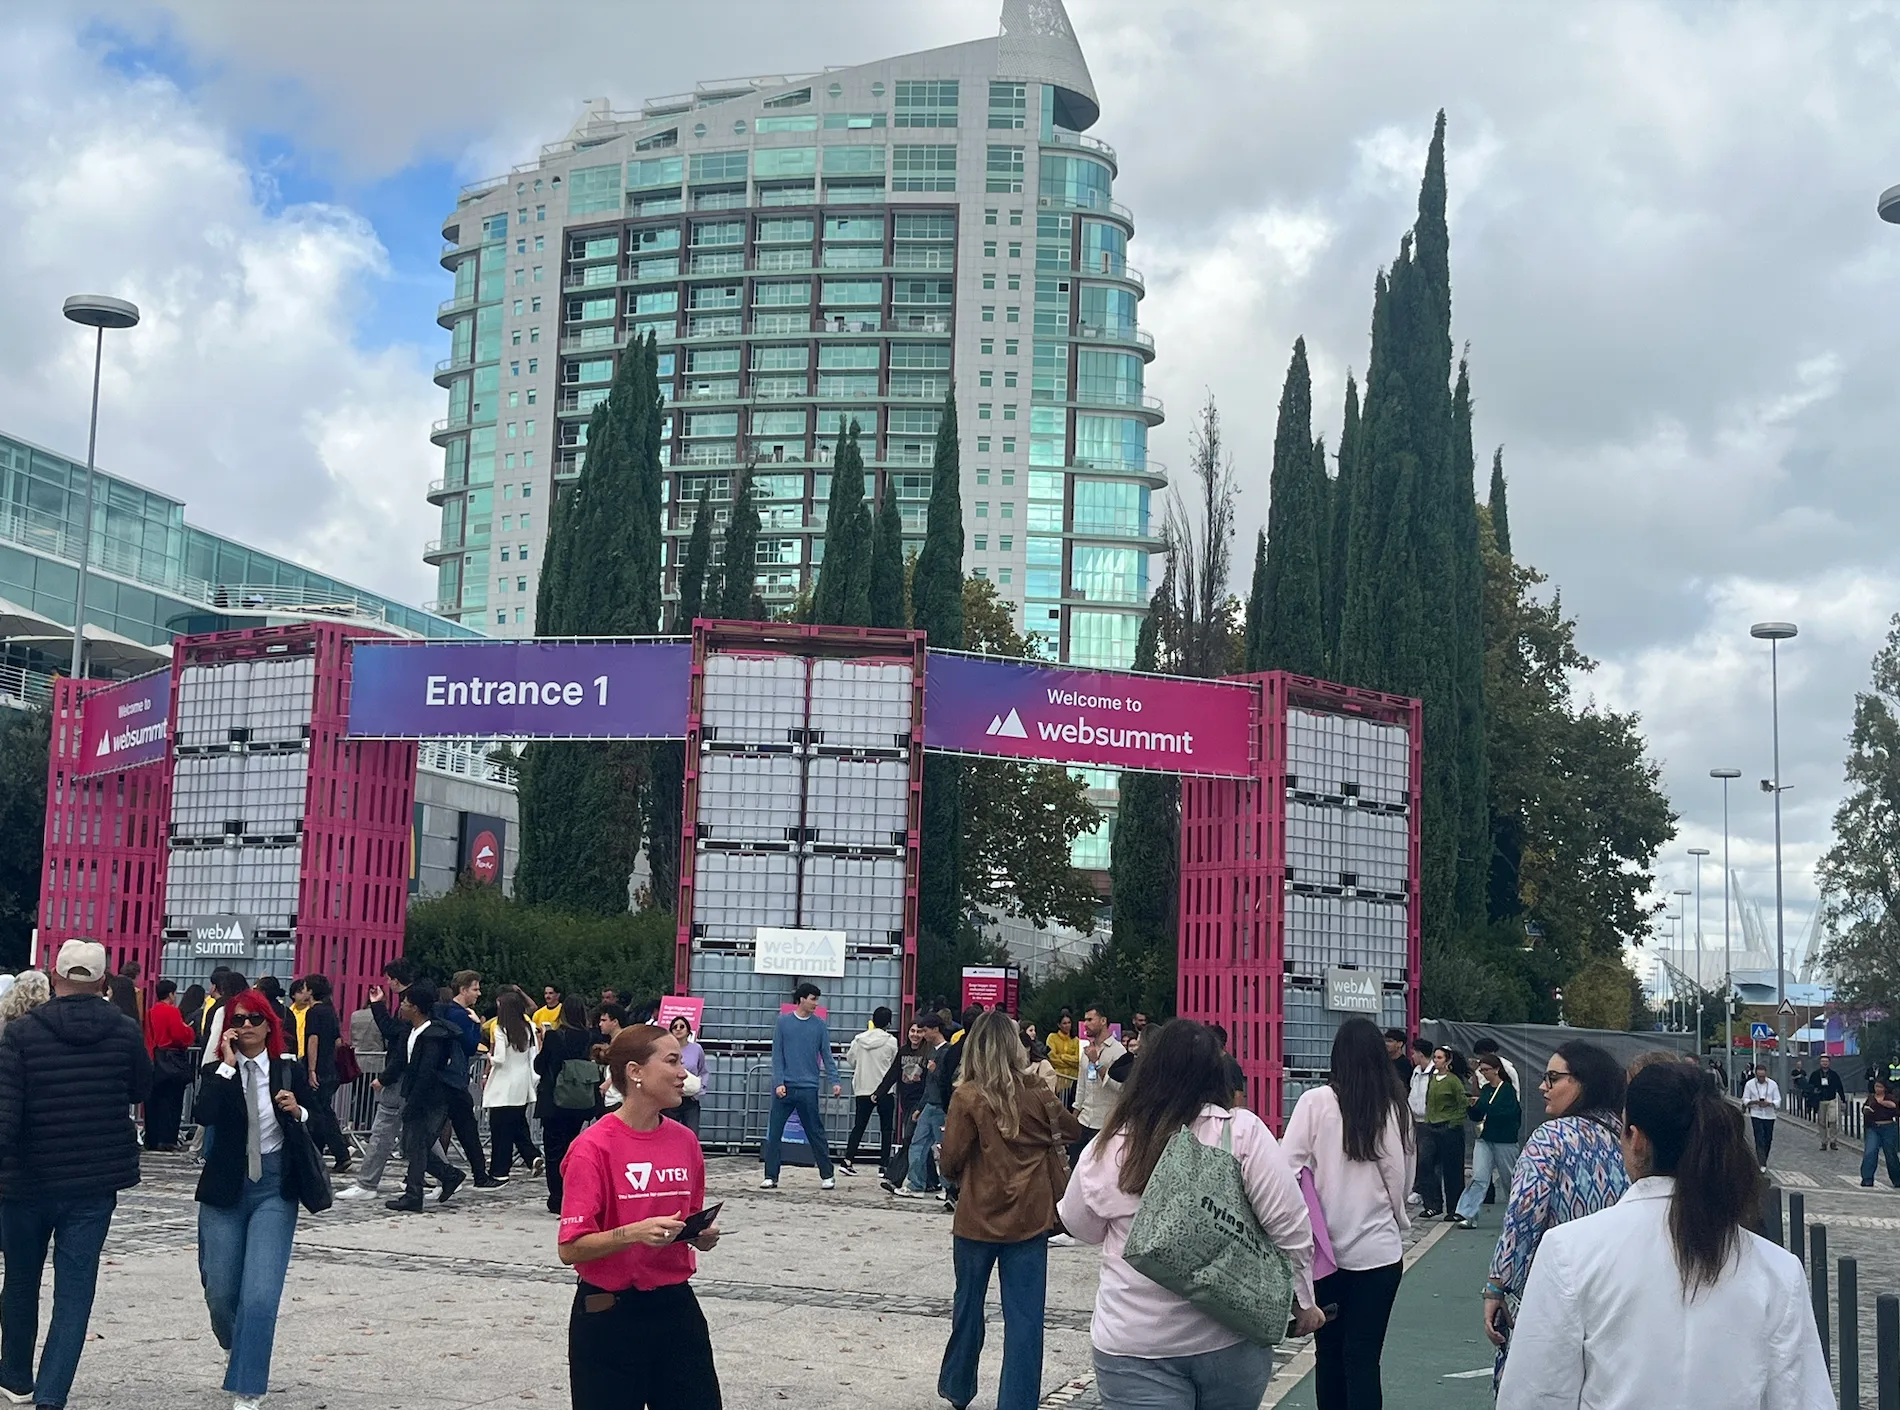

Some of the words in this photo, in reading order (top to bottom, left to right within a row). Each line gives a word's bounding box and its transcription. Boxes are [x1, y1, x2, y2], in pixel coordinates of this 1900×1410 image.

[425, 675, 584, 706] Entrance
[593, 675, 609, 706] 1
[118, 701, 143, 719] Welcome
[144, 698, 151, 710] to
[1047, 688, 1122, 711] Welcome
[1125, 697, 1142, 712] to
[113, 717, 168, 752] websummit
[1037, 717, 1194, 754] websummit
[196, 923, 224, 940] web
[195, 940, 245, 955] summit
[763, 937, 805, 954] web
[762, 956, 837, 972] summit
[1333, 977, 1358, 993] web
[1333, 995, 1377, 1009] summit
[655, 1168, 689, 1183] VTEX
[1201, 1196, 1244, 1235] flying
